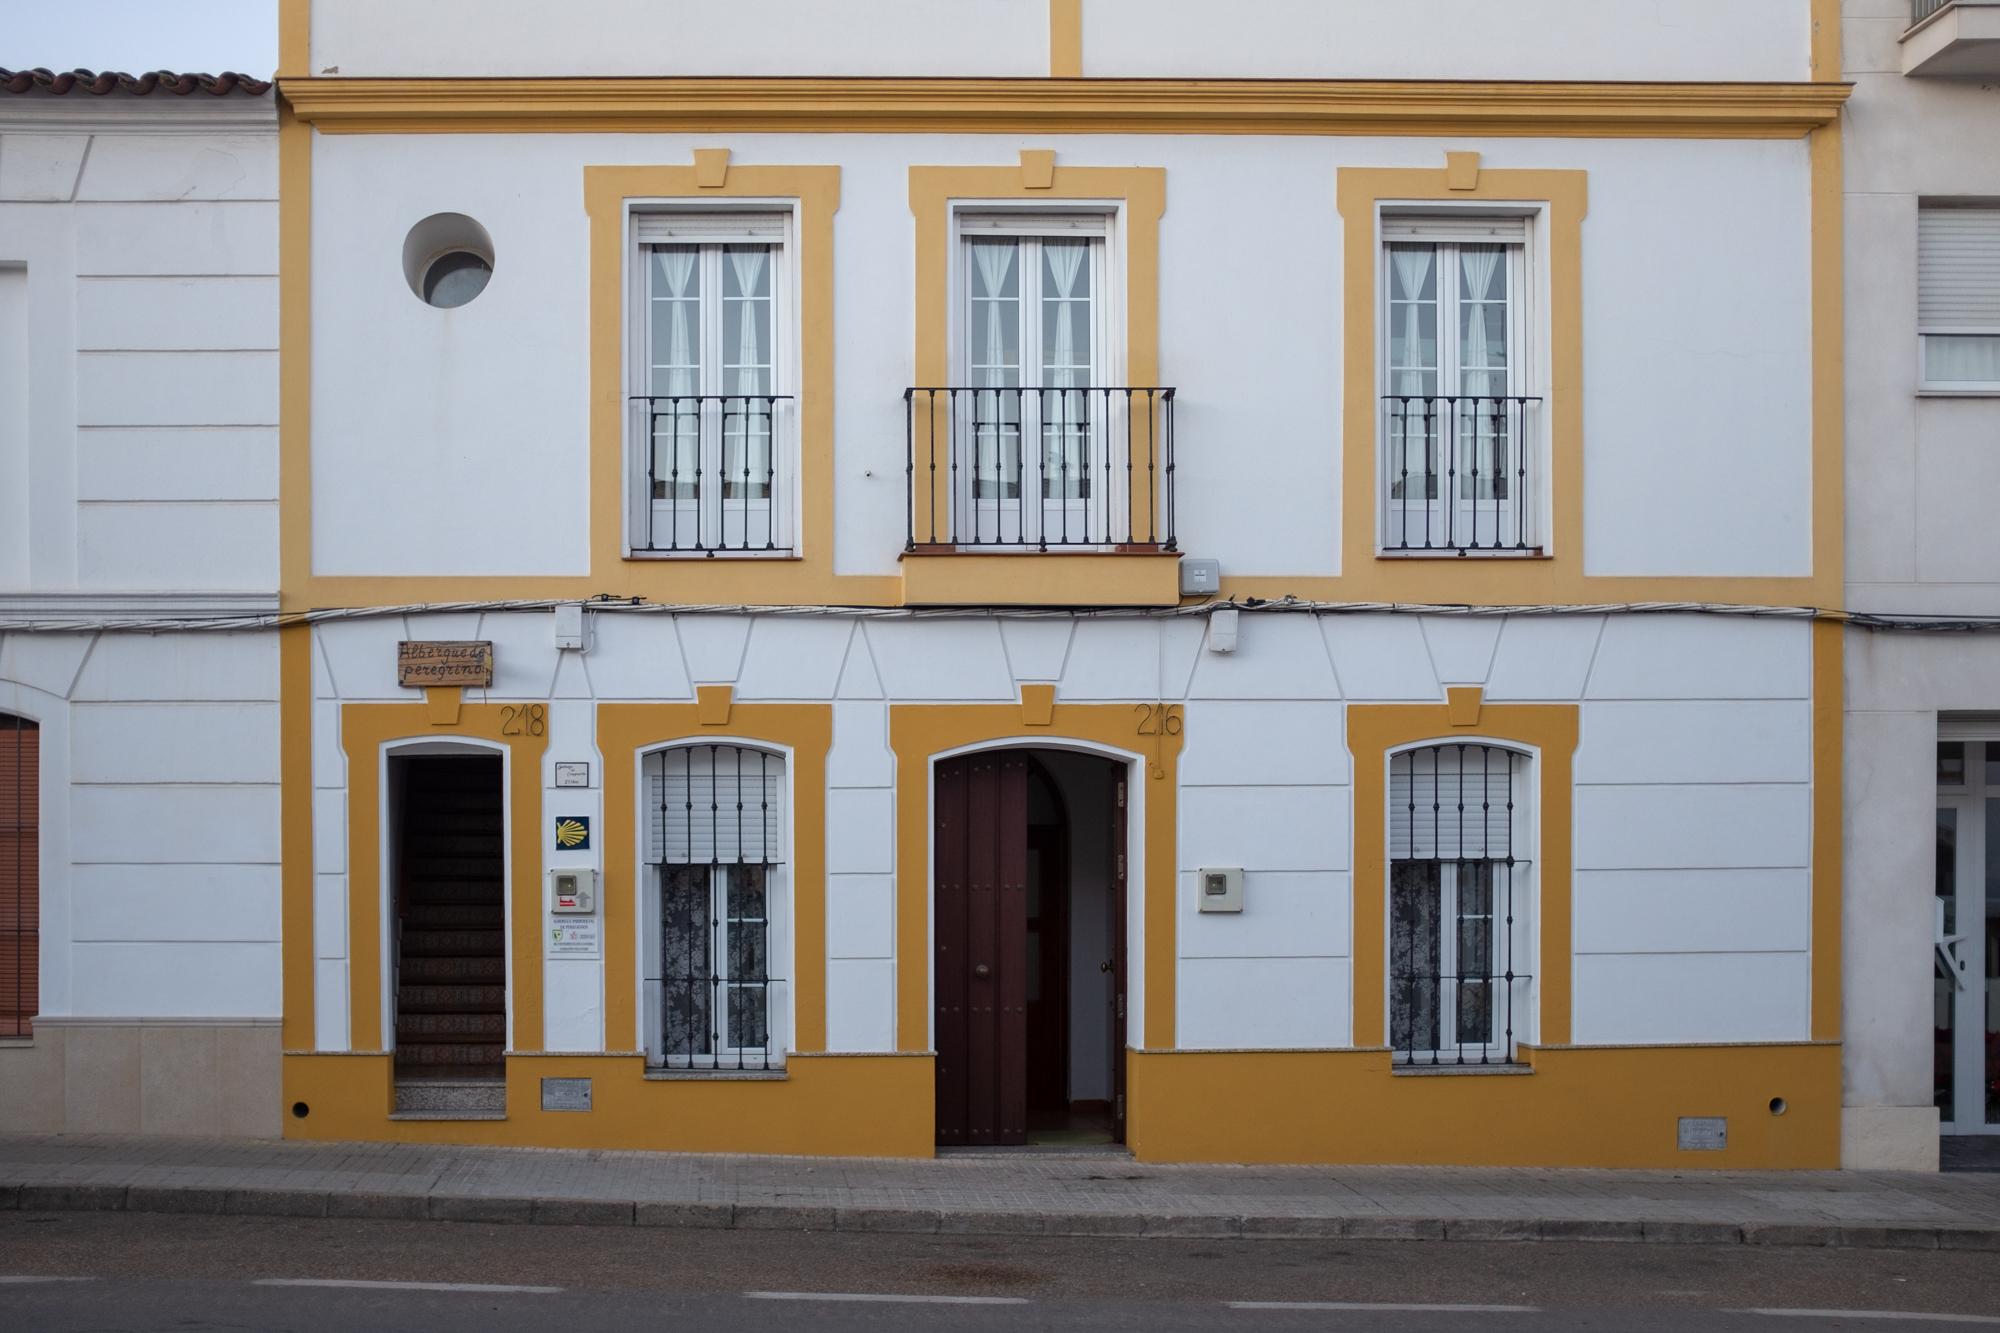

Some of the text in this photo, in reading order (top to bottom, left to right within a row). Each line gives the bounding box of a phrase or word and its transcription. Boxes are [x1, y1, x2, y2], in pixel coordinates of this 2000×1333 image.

[400, 644, 467, 664] Albergue
[500, 703, 545, 737] 218
[1134, 702, 1182, 736] 216
